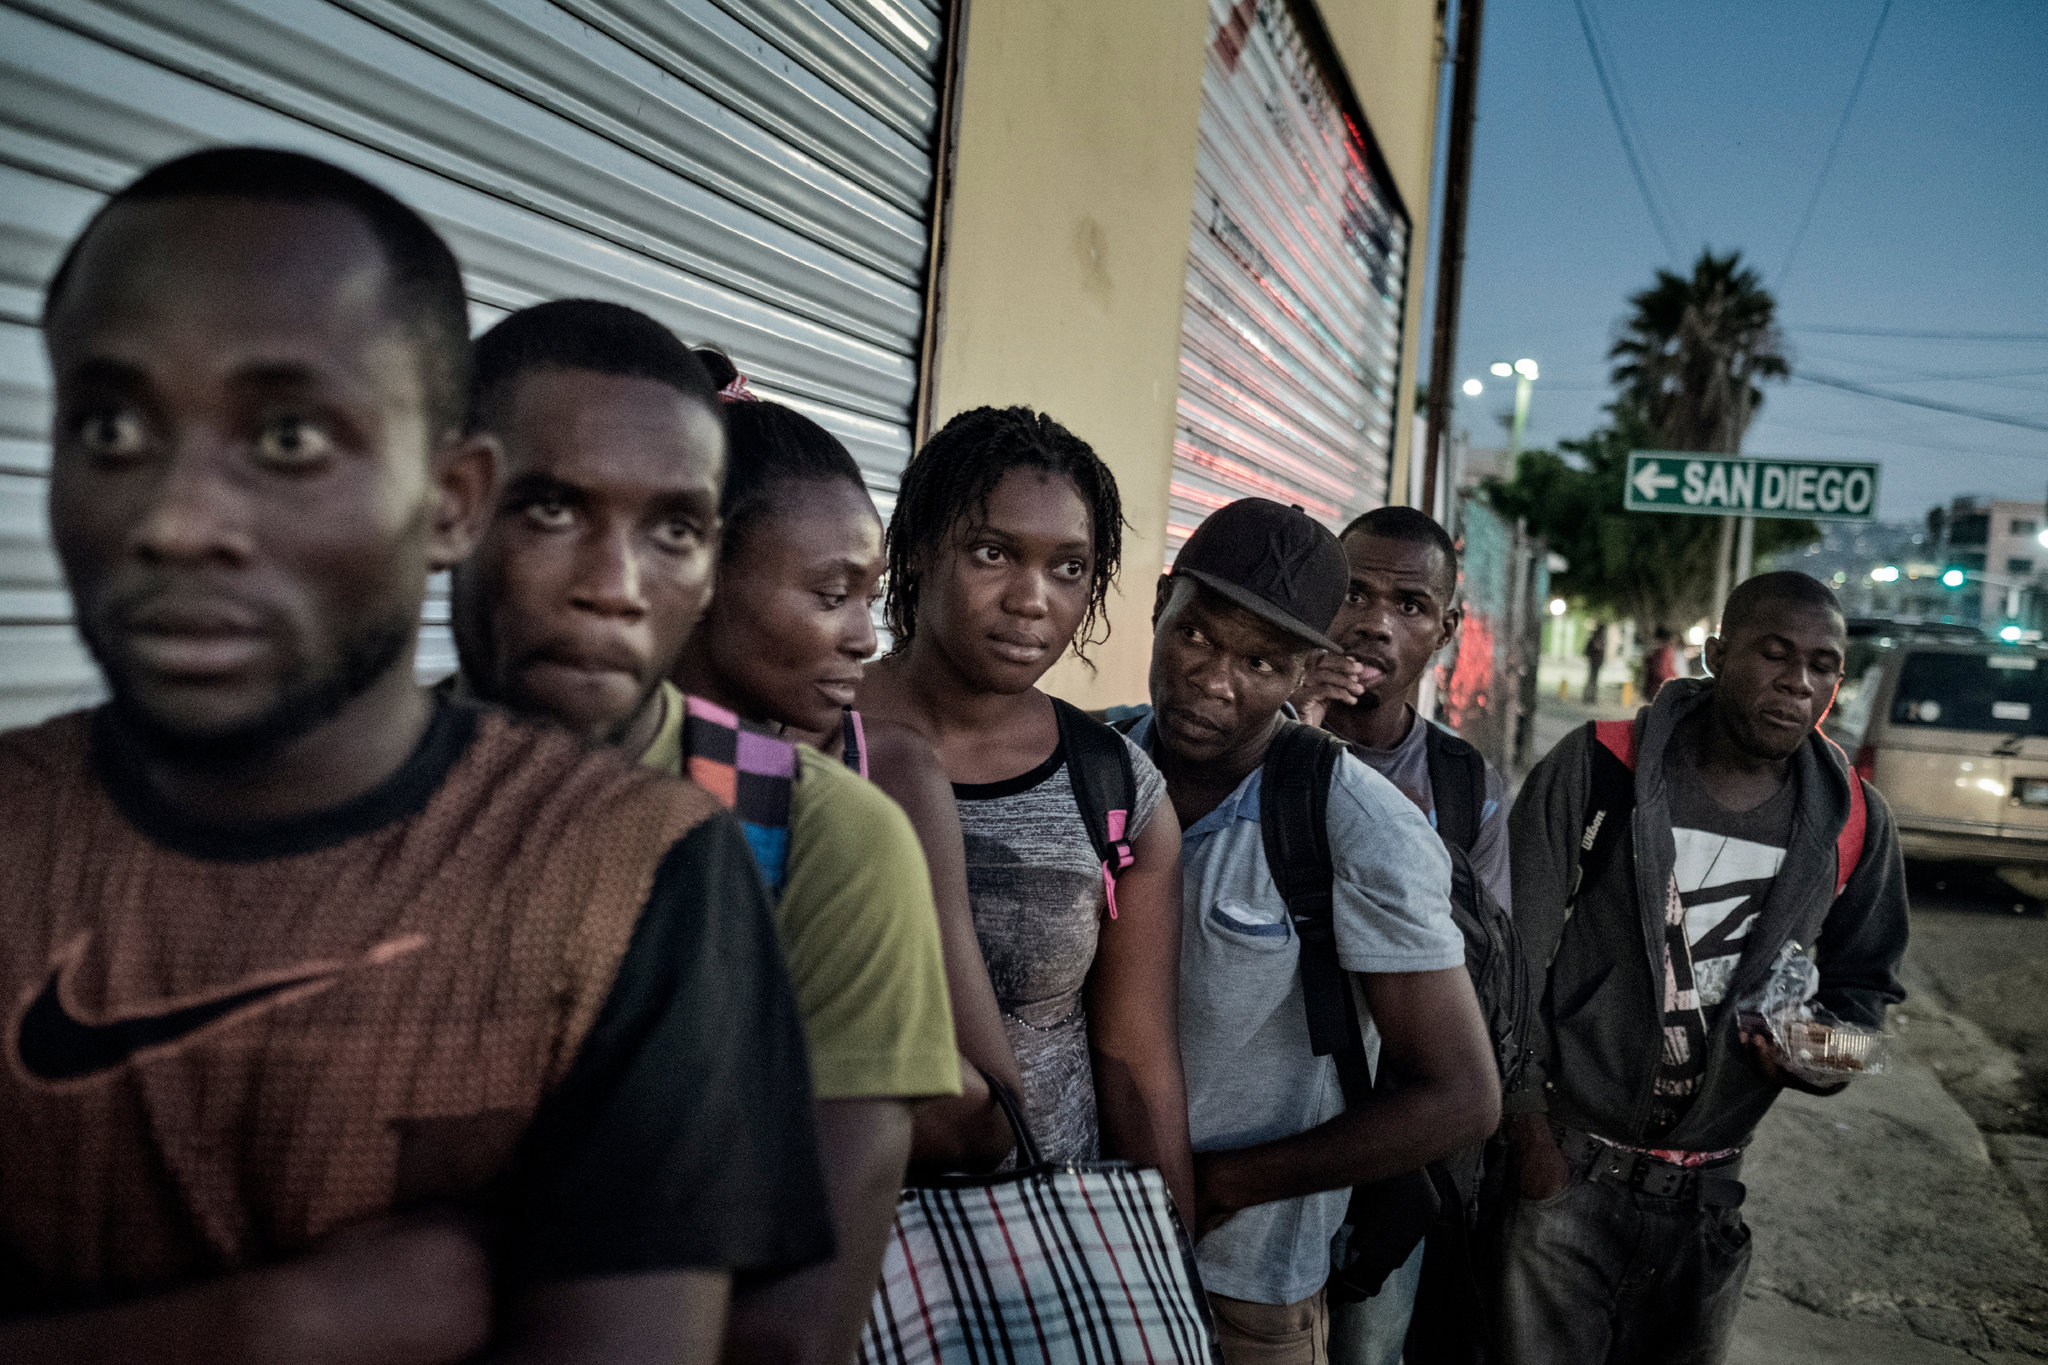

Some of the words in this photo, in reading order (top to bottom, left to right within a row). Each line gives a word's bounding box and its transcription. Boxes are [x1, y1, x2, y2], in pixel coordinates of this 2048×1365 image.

[1681, 460, 1754, 508] SAN
[1761, 464, 1872, 514] DIEGO
[1580, 810, 1606, 851] Wilson
